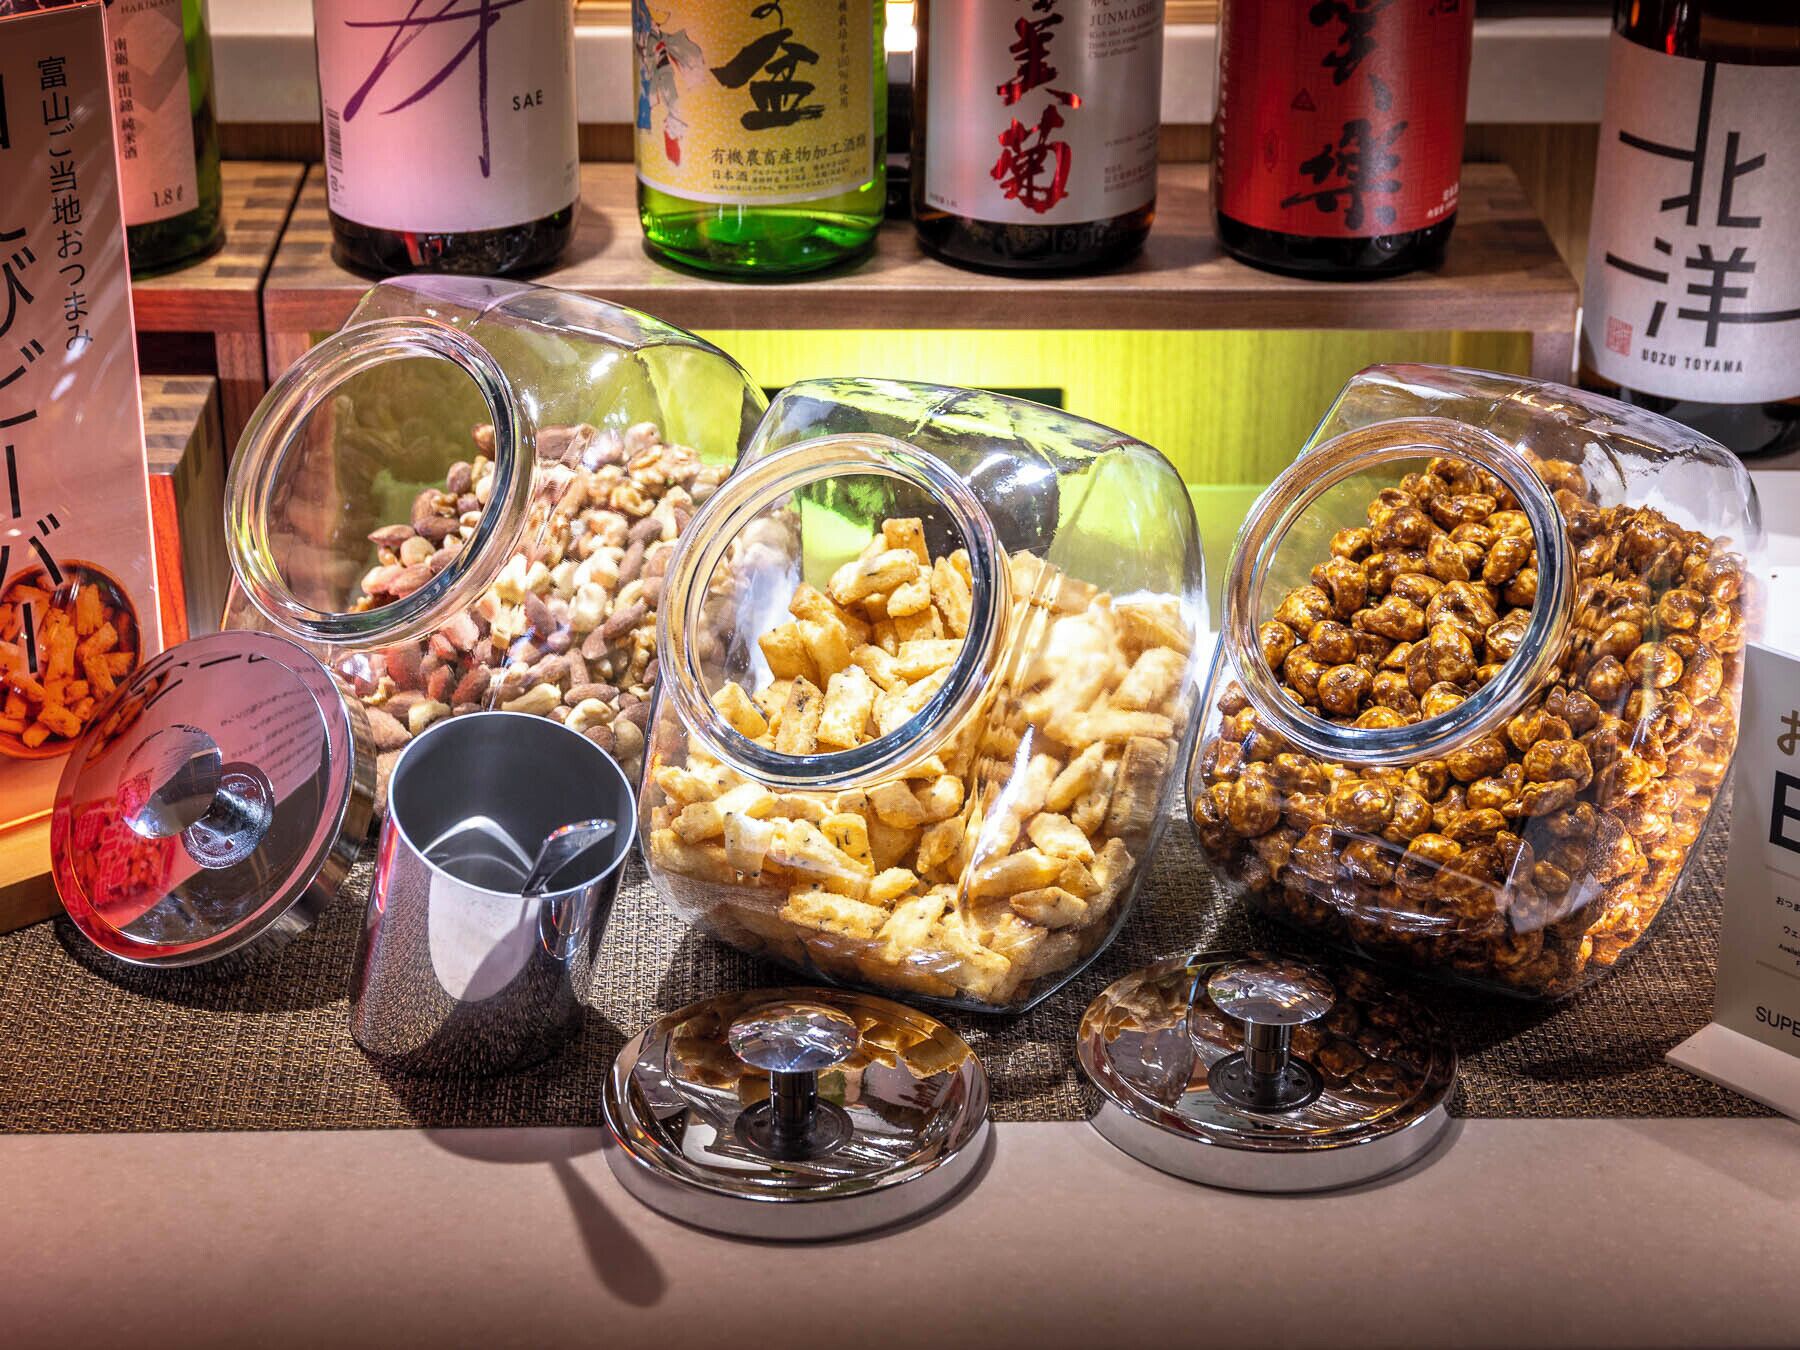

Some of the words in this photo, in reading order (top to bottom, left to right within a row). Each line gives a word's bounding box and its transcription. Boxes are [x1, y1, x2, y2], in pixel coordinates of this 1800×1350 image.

[512, 89, 544, 111] SAE
[712, 169, 748, 182] 日本酒
[37, 55, 93, 352] 富山ご当地おつまみ
[1606, 61, 1800, 348] 北洋
[1642, 348, 1676, 367] UOZU
[1685, 357, 1743, 373] TOYAMA
